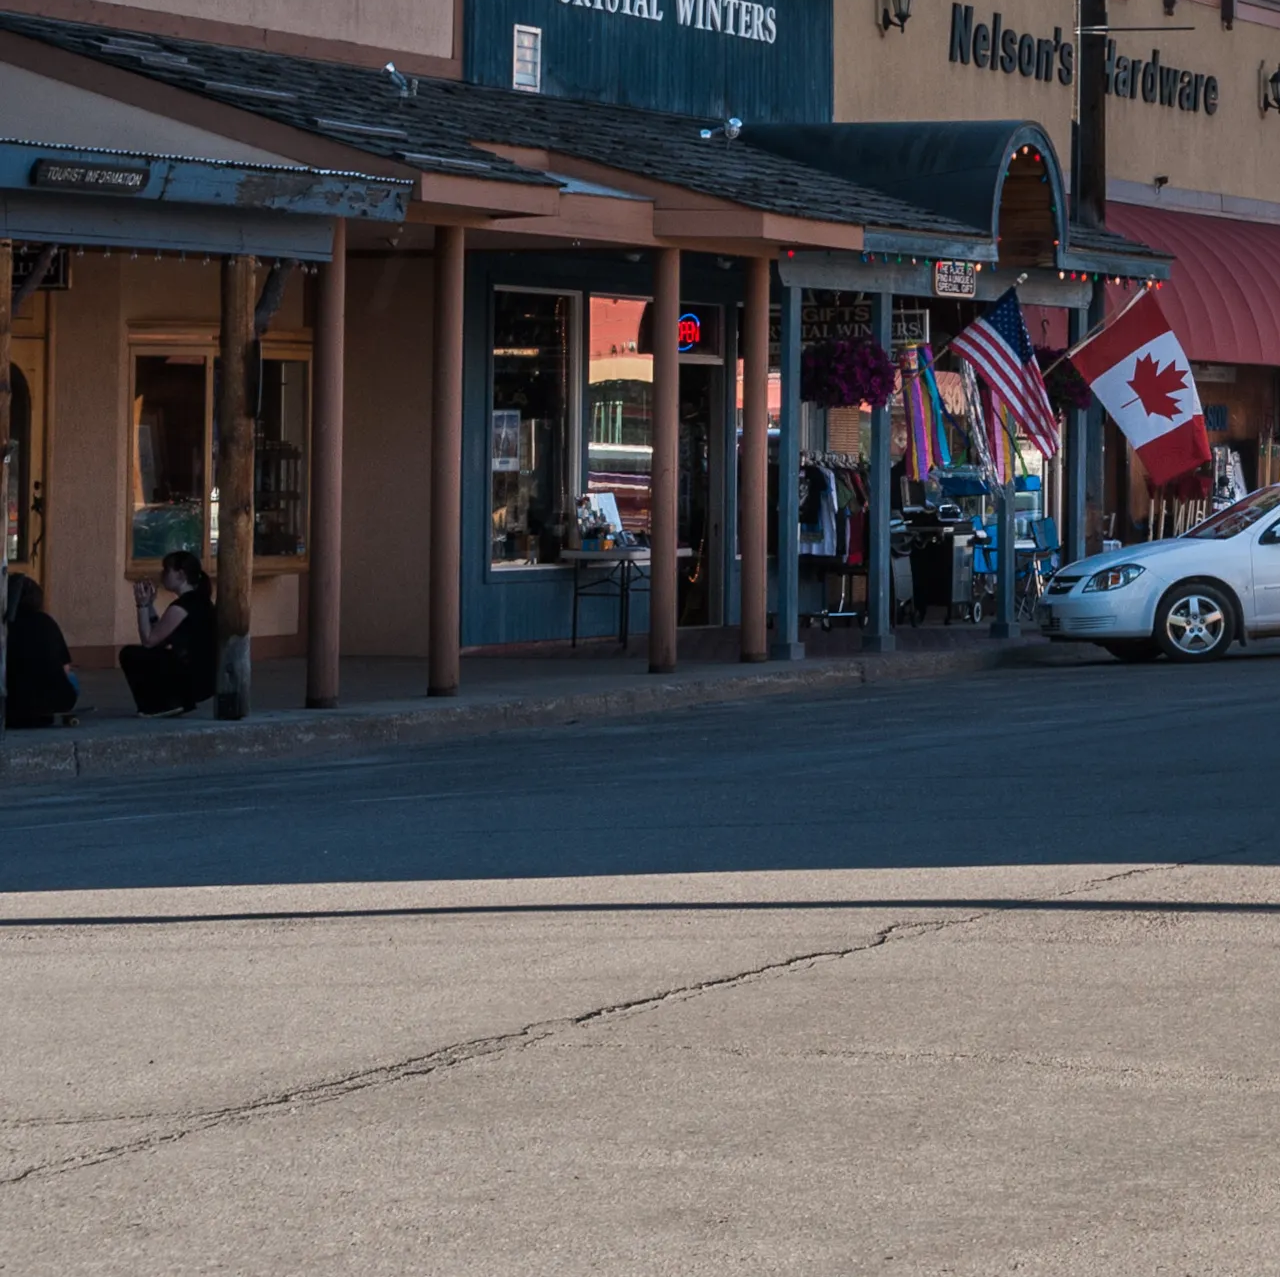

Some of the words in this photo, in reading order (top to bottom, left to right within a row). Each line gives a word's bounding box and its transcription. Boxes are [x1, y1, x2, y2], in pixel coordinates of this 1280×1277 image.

[949, 2, 1074, 86] Nelson's
[48, 166, 85, 182] TOURIST
[84, 169, 143, 186] INFORMATION
[803, 307, 869, 322] GIFTS
[678, 321, 700, 343] PEN
